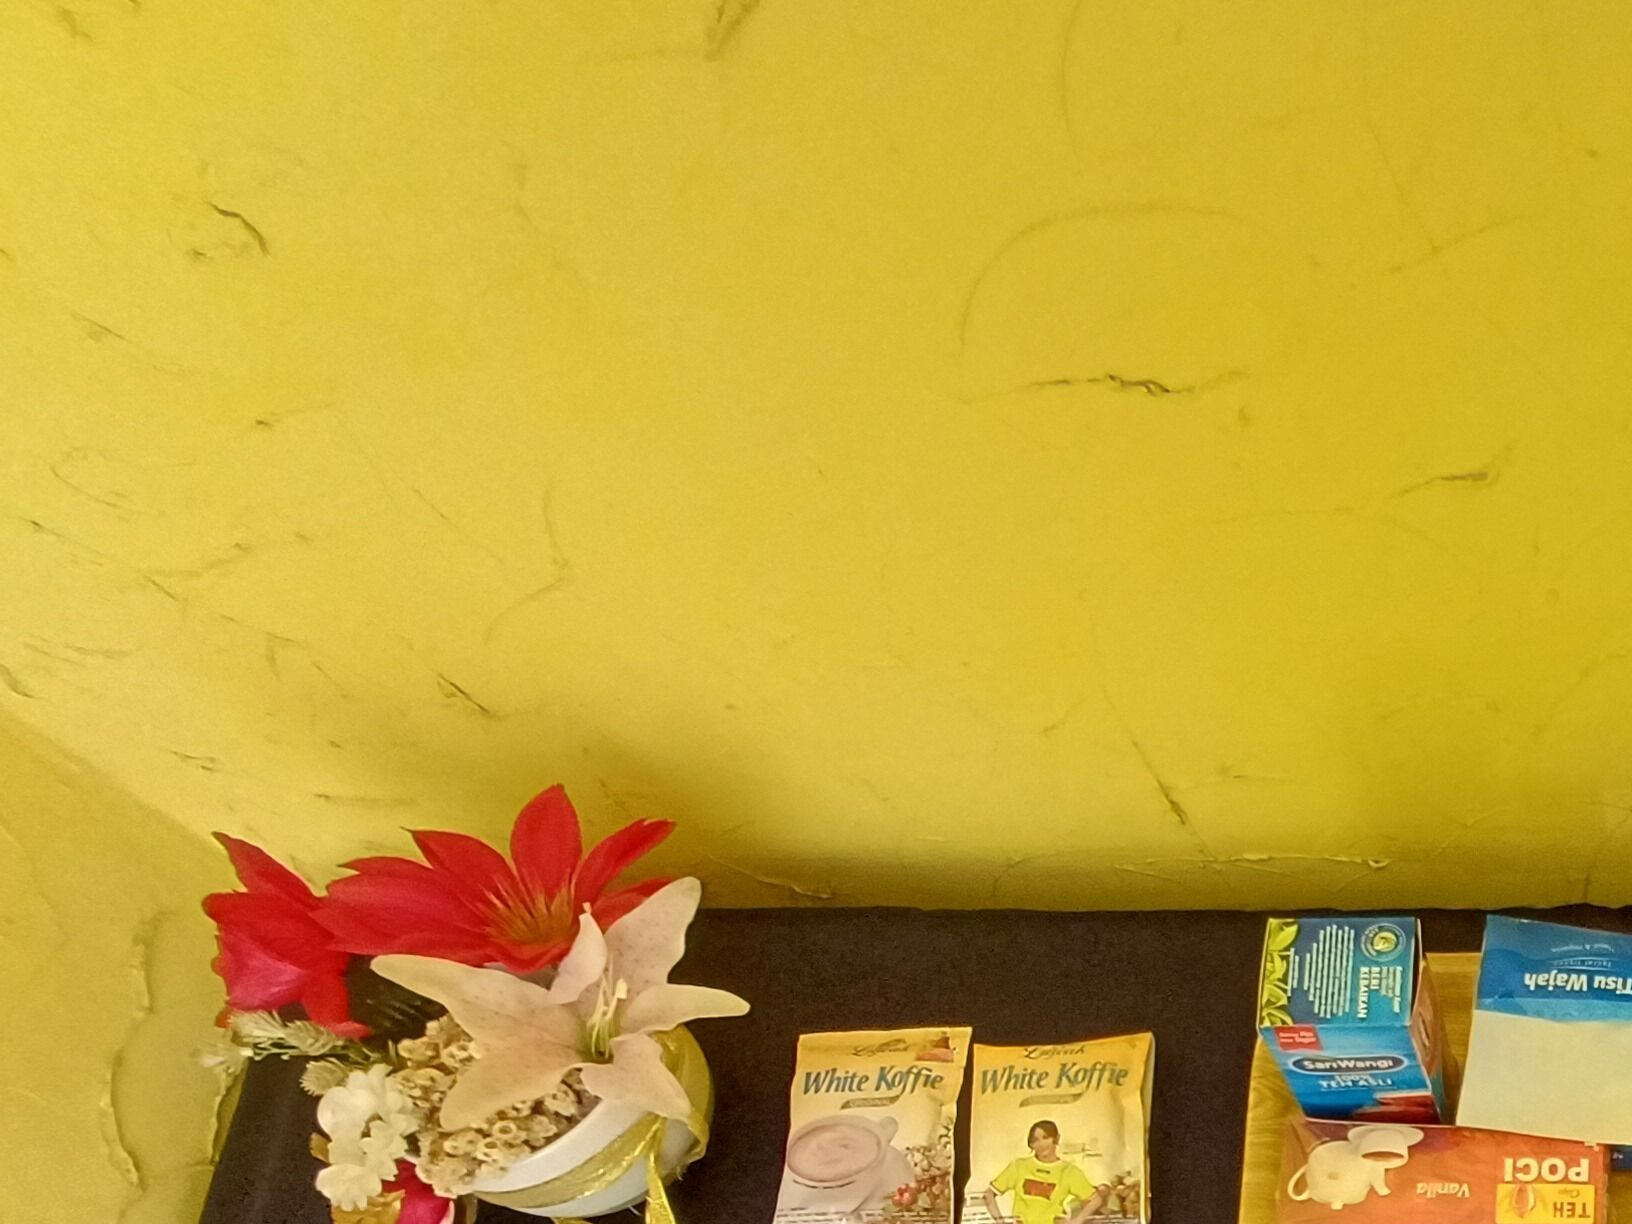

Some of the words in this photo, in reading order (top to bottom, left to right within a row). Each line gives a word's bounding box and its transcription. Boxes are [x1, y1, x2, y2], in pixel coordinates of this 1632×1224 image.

[1524, 970, 1588, 991] Wajah
[1303, 1058, 1394, 1071] SariWangi
[803, 1067, 869, 1096] White
[874, 1065, 944, 1096] Koffie
[981, 1064, 1050, 1095] White
[1055, 1061, 1129, 1093] Koffie
[1503, 1157, 1590, 1183] POCI
[1416, 1182, 1470, 1199] Vanila
[1553, 1201, 1591, 1218] TEH
